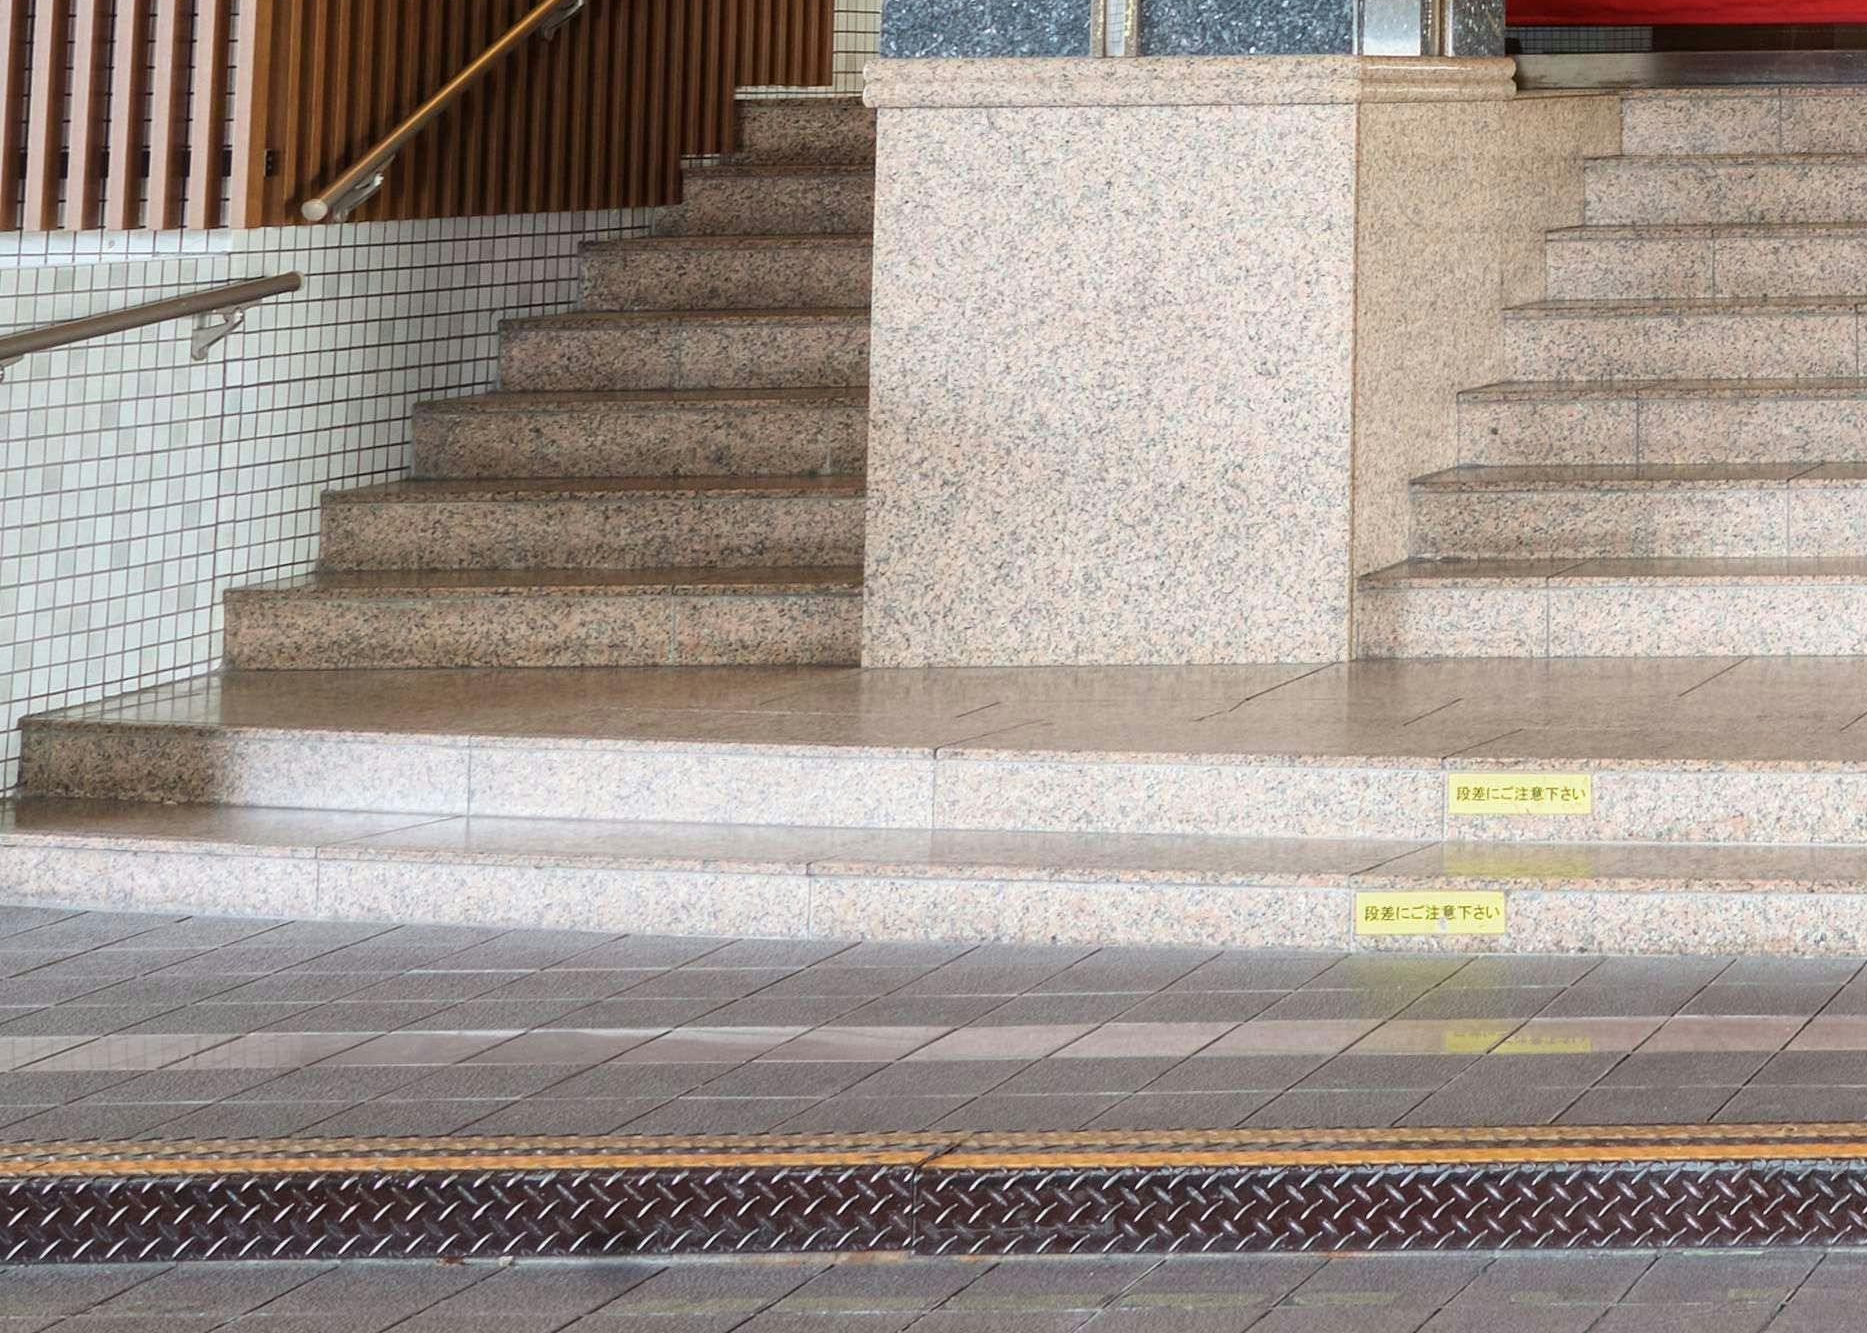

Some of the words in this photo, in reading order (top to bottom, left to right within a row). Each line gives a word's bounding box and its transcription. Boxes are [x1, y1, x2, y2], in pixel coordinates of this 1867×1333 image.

[1456, 785, 1586, 802] 段差にご注意下さい
[1364, 904, 1500, 922] 段差にご注意下さい
